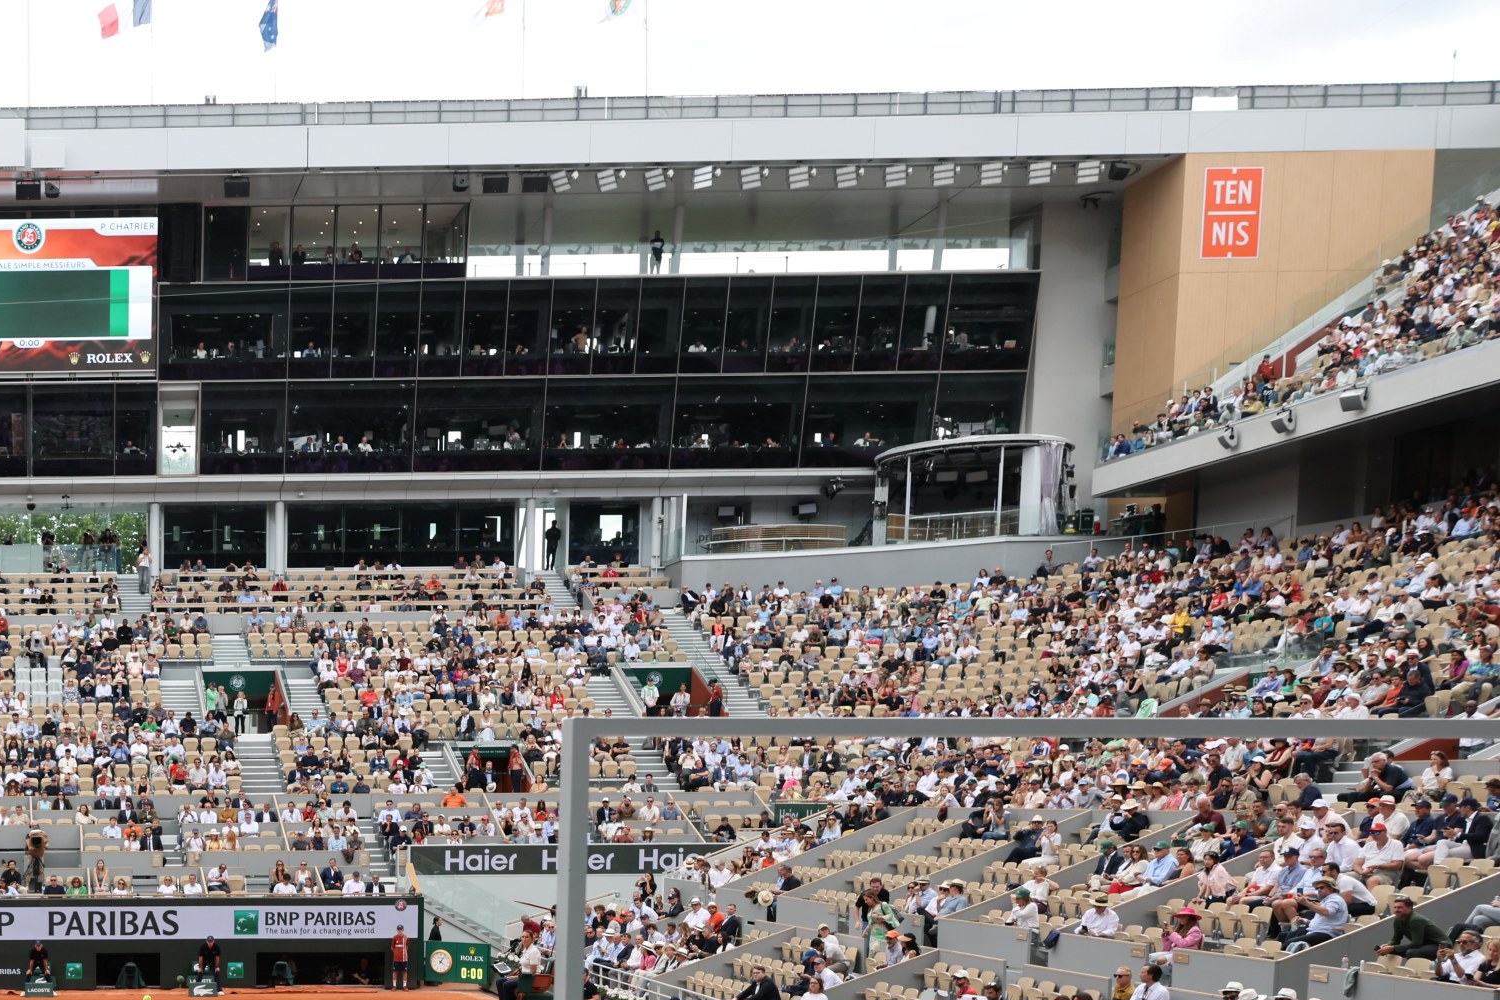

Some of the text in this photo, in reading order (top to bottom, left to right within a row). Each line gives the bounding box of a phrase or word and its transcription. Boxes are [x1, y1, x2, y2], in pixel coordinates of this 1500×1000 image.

[1213, 180, 1252, 204] TEN
[109, 222, 155, 231] CHATRIER
[1212, 221, 1250, 246] NIS
[43, 261, 86, 269] MESSIEURS
[86, 353, 133, 364] ROLEX
[445, 847, 704, 871] Haier Her Hai
[48, 910, 180, 936] PARIBAS
[265, 910, 376, 926] BNP PARIBAS
[320, 927, 352, 935] changing
[461, 967, 483, 980] 0:00
